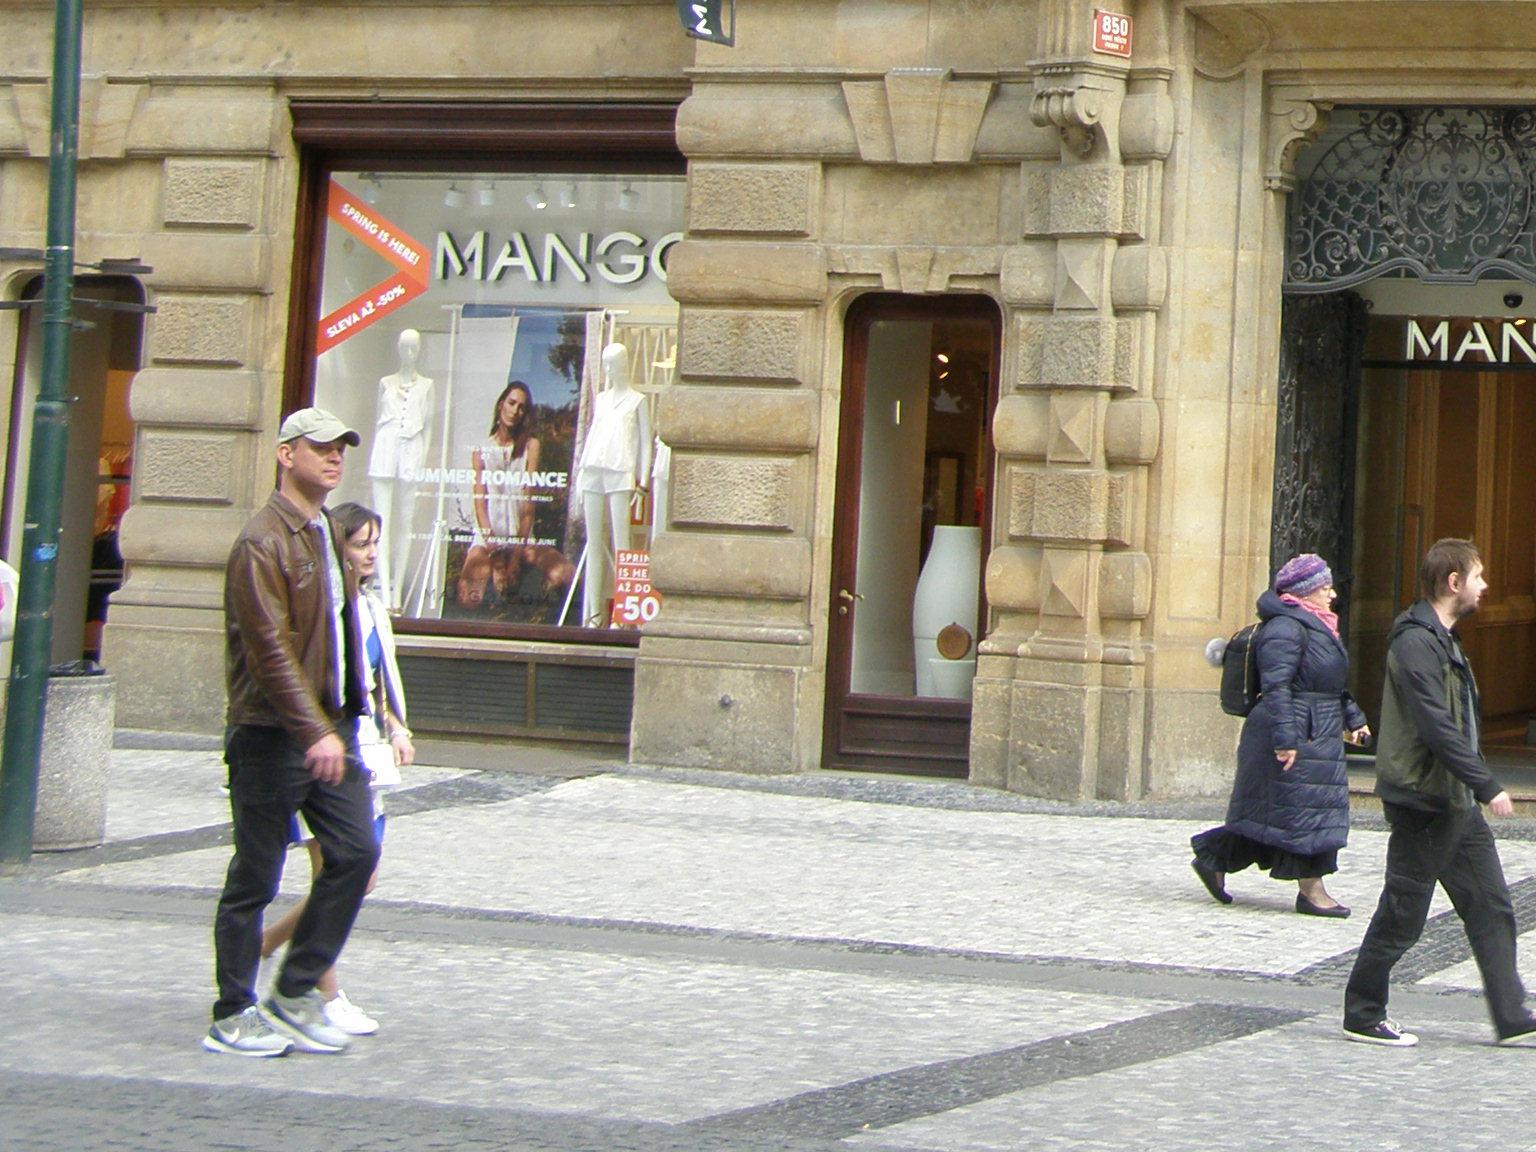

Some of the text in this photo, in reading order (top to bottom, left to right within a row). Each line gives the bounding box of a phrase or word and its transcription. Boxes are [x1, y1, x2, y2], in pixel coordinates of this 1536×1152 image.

[1102, 15, 1129, 37] 850
[341, 203, 421, 266] SPRING IS HERE!
[326, 284, 406, 338] SLEVA AŽ -50%
[481, 469, 569, 487] ROMANCE
[619, 567, 648, 578] IS HE
[617, 581, 652, 594] AŽ DO
[616, 595, 661, 621] -50
